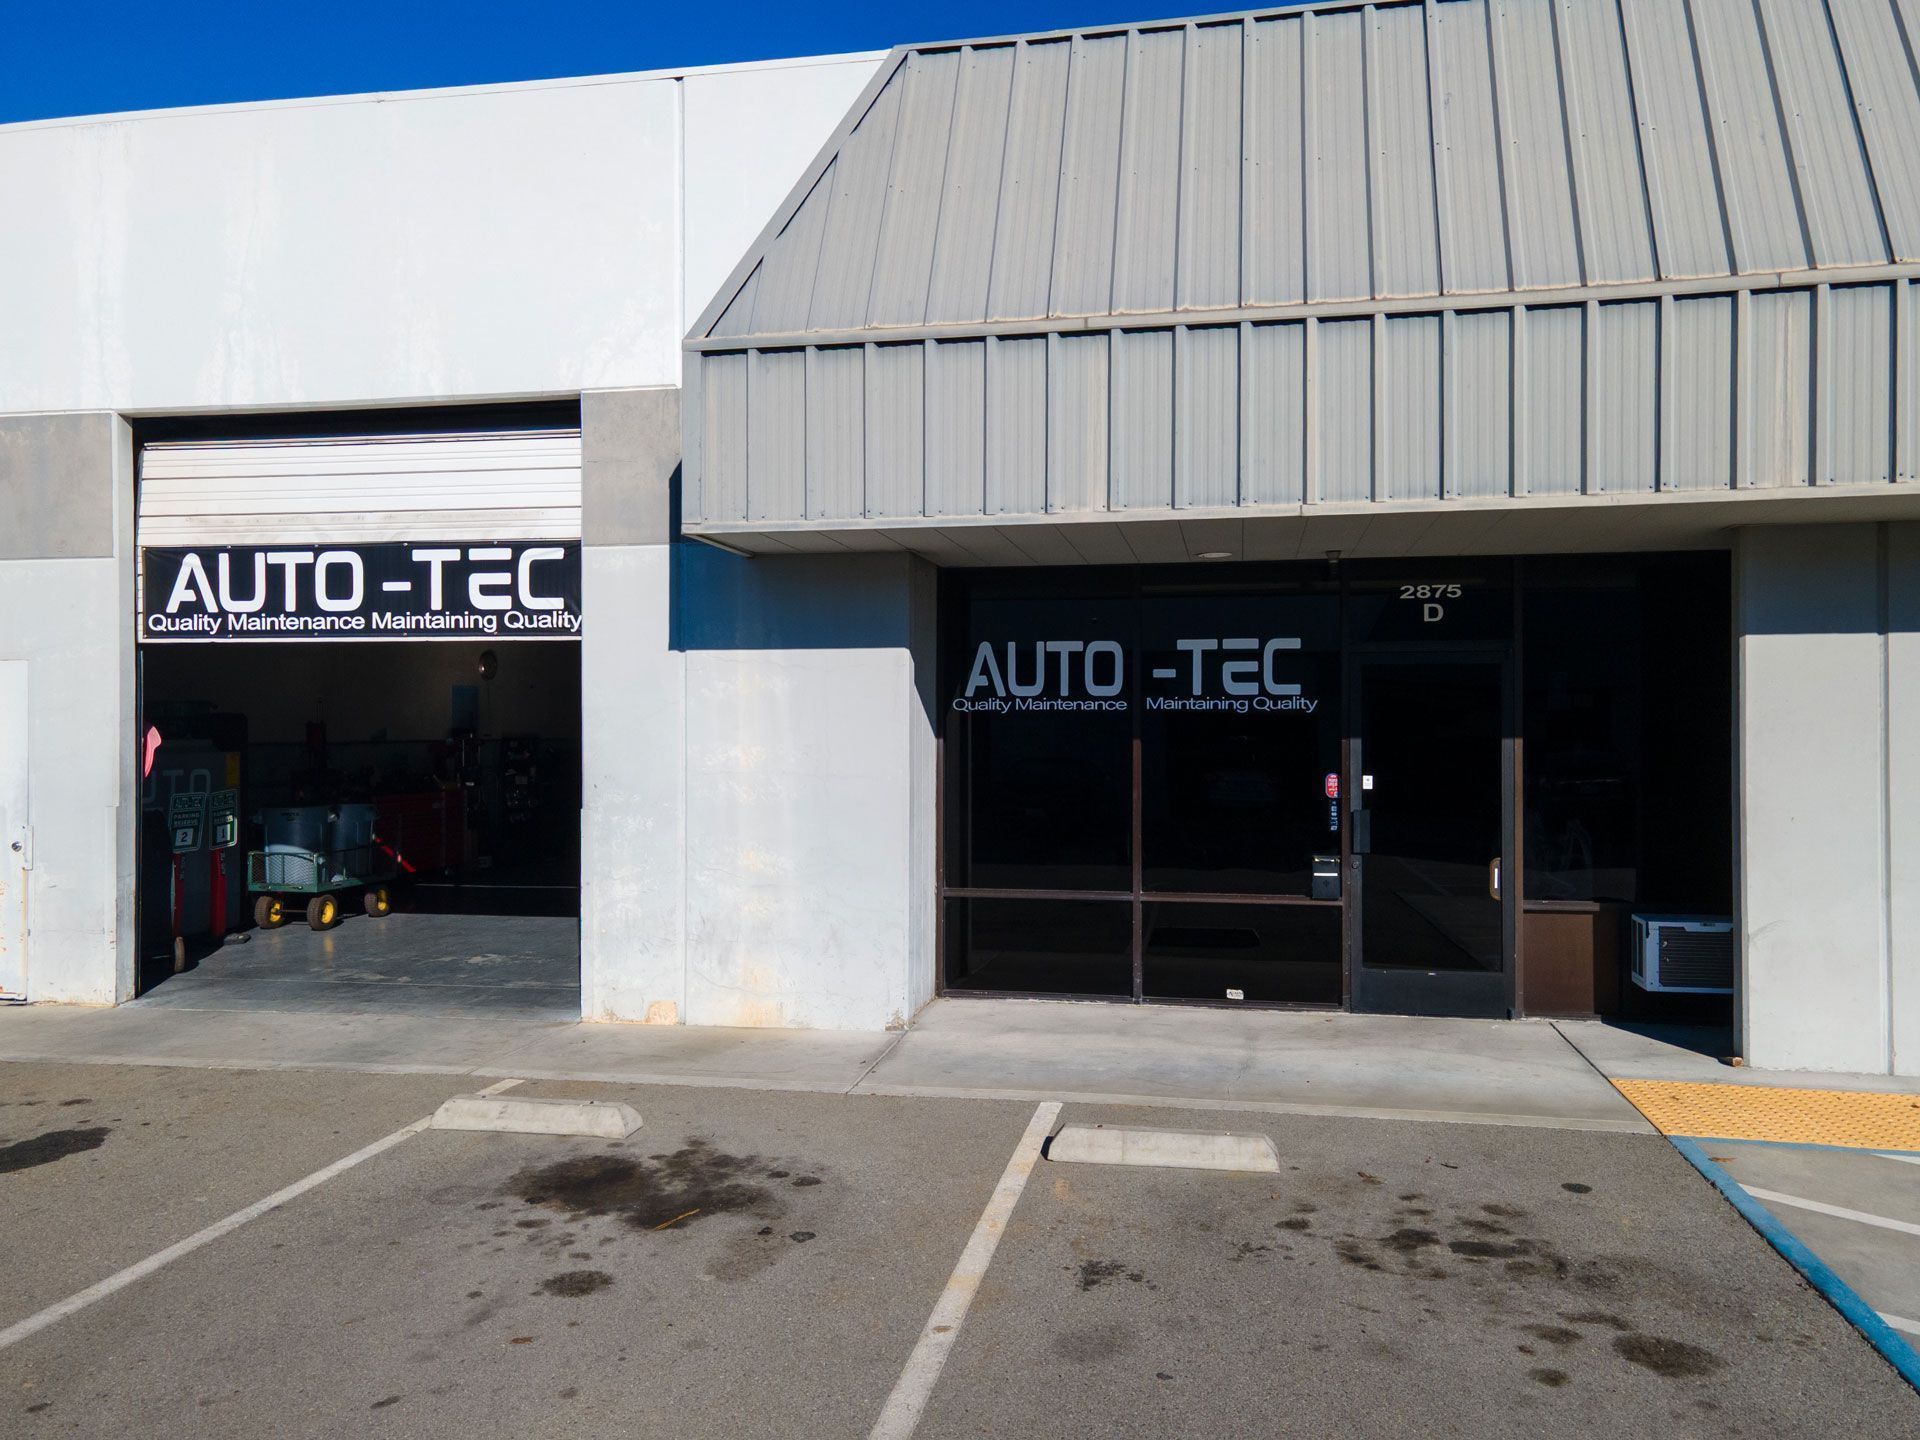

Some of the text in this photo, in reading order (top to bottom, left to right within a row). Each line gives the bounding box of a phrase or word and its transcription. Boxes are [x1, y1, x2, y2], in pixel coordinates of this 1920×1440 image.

[165, 550, 364, 613] AUTO
[1400, 584, 1462, 599] 2875
[1424, 603, 1444, 622] D
[149, 610, 582, 635] Quality Maintenance Maintaining Quality
[965, 640, 1124, 697] AUTO
[952, 696, 1318, 714] Quality Maintenance Maintaining Quality
[180, 831, 188, 843] 2
